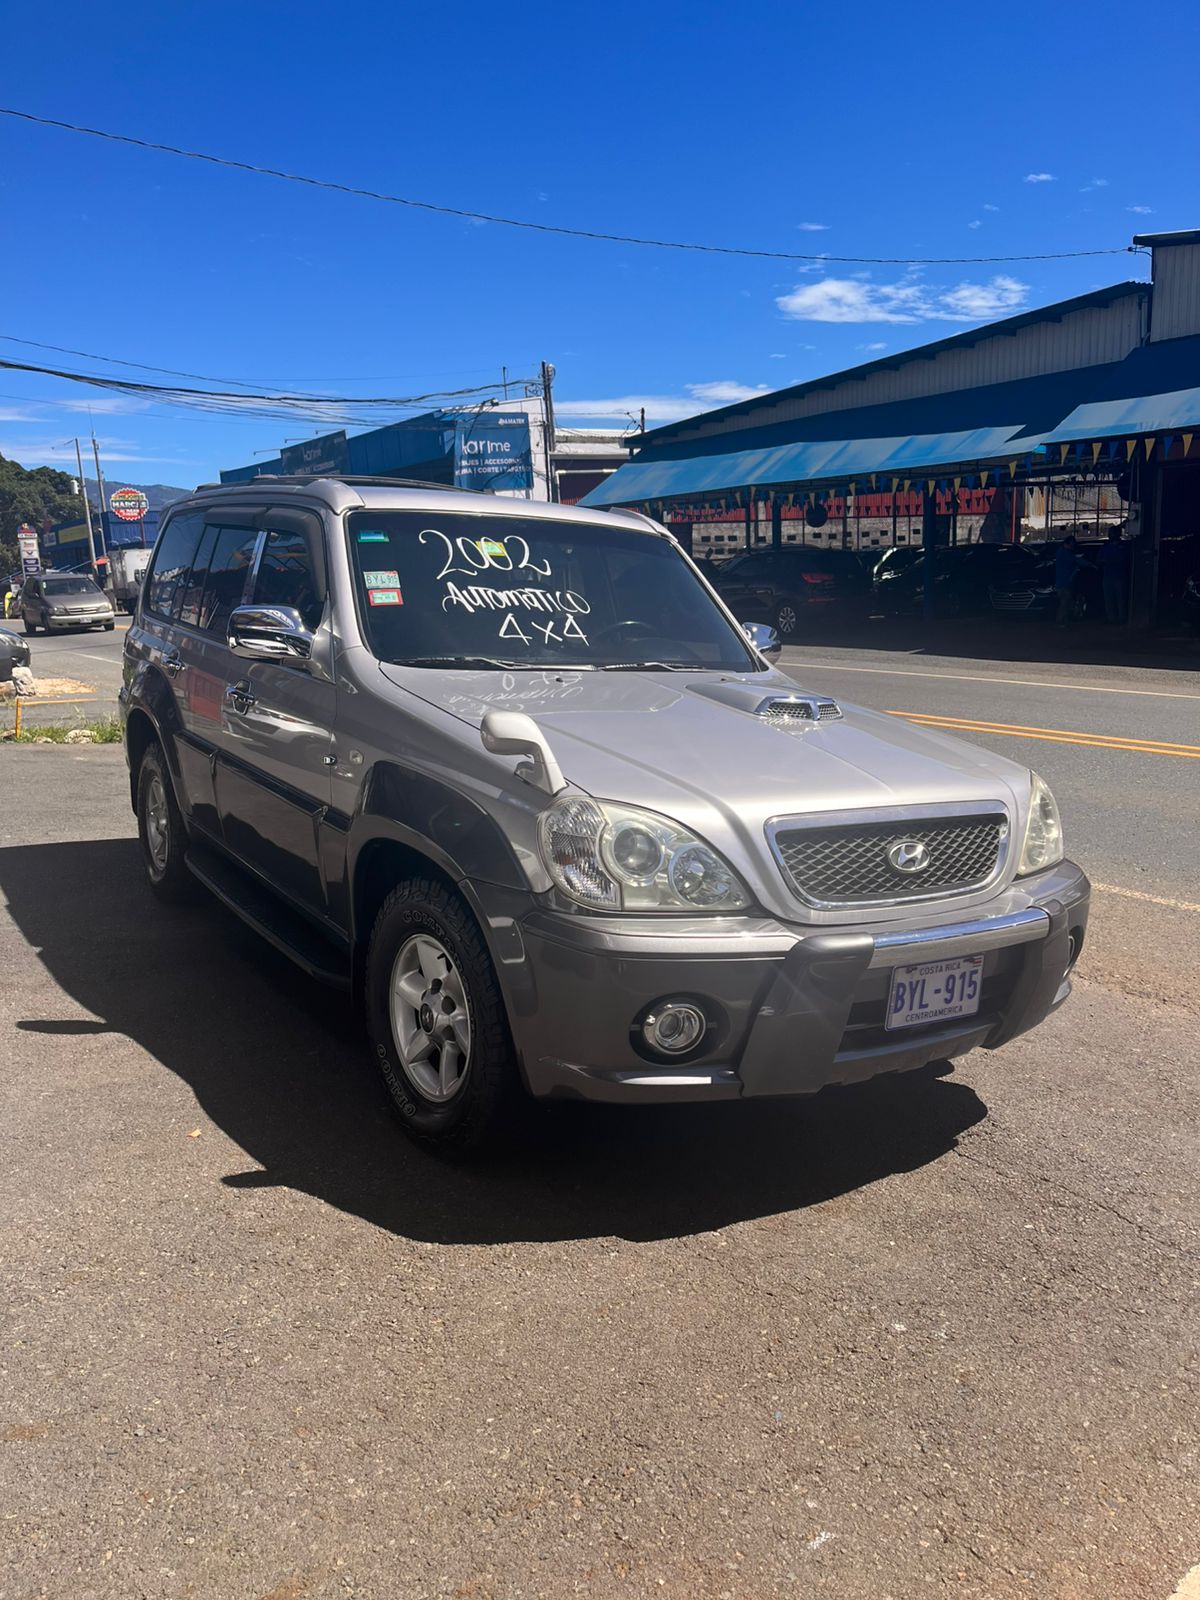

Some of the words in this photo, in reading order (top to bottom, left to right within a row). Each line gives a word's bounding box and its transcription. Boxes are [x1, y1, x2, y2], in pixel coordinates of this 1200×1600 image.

[418, 529, 552, 580] 2002
[920, 966, 943, 976] COSTA
[945, 963, 961, 971] RICA
[893, 969, 979, 1014] BYL-915
[905, 1005, 963, 1023] CENTROAMERICA
